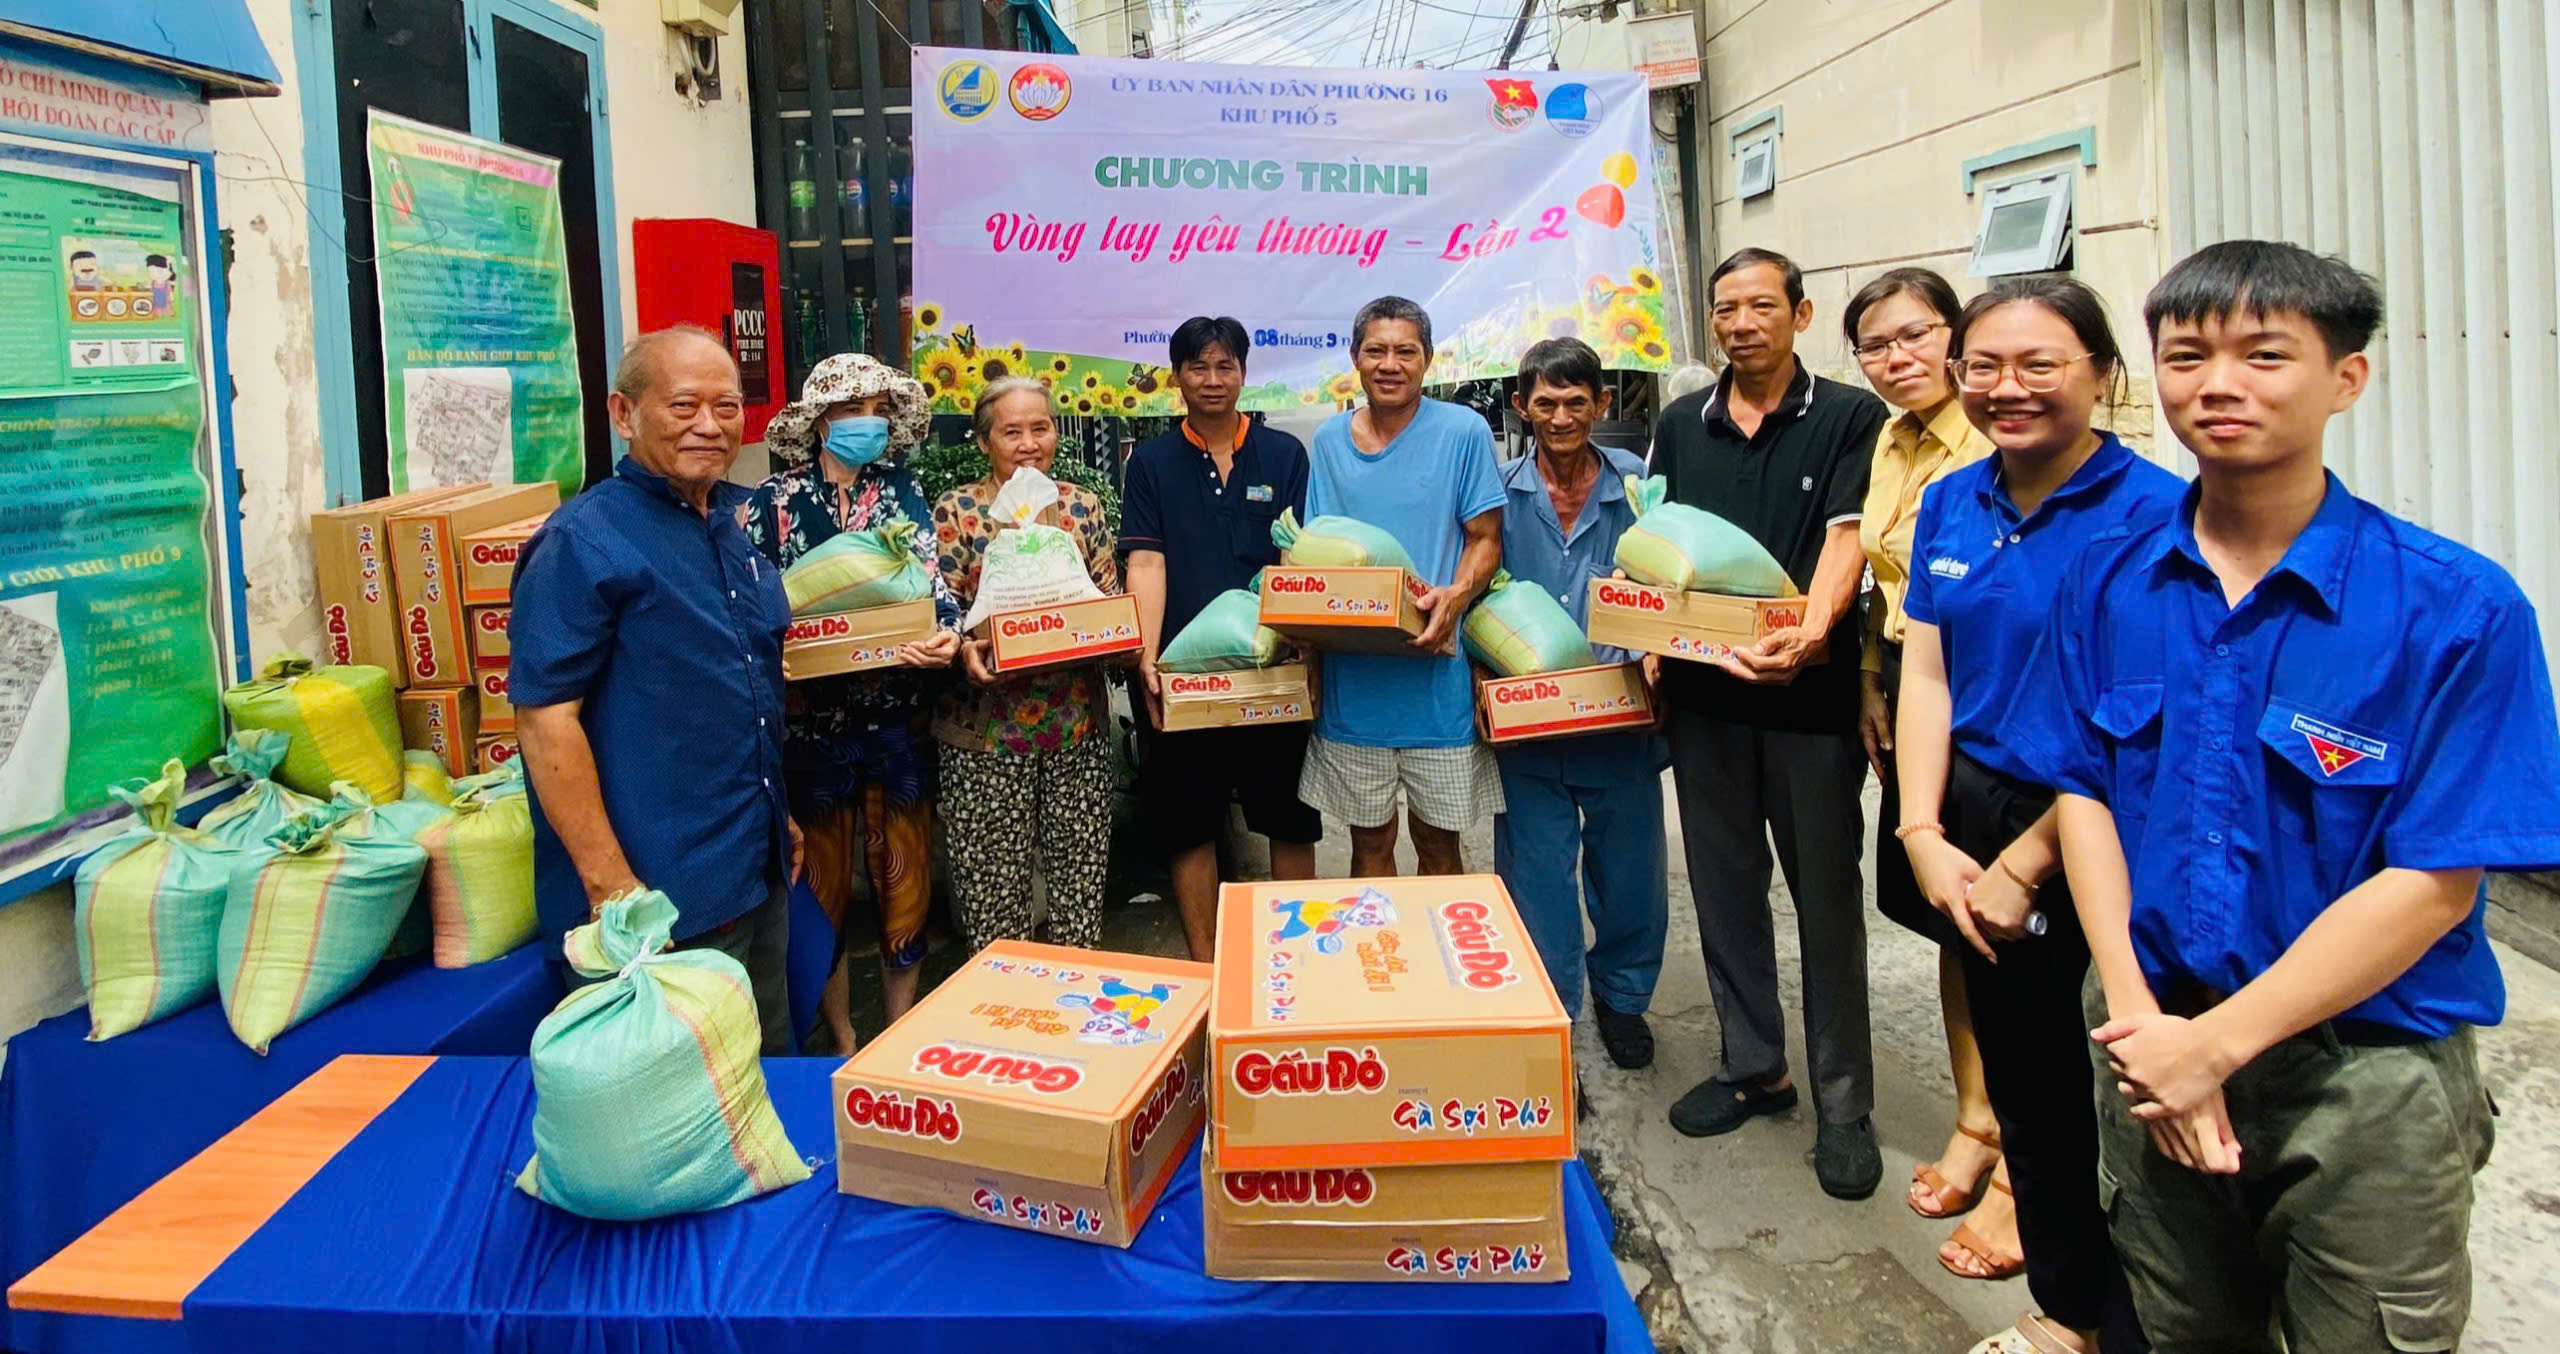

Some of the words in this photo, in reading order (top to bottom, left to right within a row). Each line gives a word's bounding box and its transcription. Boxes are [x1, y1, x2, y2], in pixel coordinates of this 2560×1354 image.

[19, 68, 55, 96] CHÍ
[60, 79, 110, 106] MINH
[165, 103, 174, 120] 4
[1112, 75, 1141, 92] ỦY
[1148, 79, 1194, 93] BAN
[1201, 77, 1264, 95] NHÂN
[1270, 79, 1318, 98] DÂN
[1323, 82, 1416, 102] PHƯỜNG
[1424, 88, 1448, 103] 16
[3, 96, 39, 124] HỘI
[1221, 107, 1266, 124] KHU
[1271, 104, 1319, 125] PHỐ
[1324, 112, 1338, 126] 5
[1095, 156, 1284, 191] CHƯƠNG
[1295, 156, 1428, 195] TRÌNH
[985, 212, 1087, 263] Vòng
[1100, 215, 1161, 263] tay
[1169, 215, 1242, 263] yêu
[1256, 216, 1388, 268] thương
[1439, 219, 1520, 262] Lần
[1529, 205, 1568, 242] 2
[734, 309, 765, 336] PCCC
[1124, 330, 1171, 344] Phườn
[1254, 328, 1279, 347] 08
[1280, 332, 1323, 349] tháng
[1326, 333, 1337, 347] 9
[64, 558, 115, 579] KHU
[119, 545, 165, 573] PHỐ
[331, 635, 351, 665] ấu
[1235, 1051, 1325, 1095] Gấu
[846, 1087, 913, 1133] Gấu
[1393, 1101, 1432, 1131] Gà
[1442, 1100, 1486, 1134] Sợi
[1495, 1097, 1551, 1127] Phở
[973, 1188, 1005, 1215] Gà
[1013, 1196, 1048, 1227] Sợi
[1053, 1202, 1102, 1233] Phở
[1386, 1248, 1425, 1272] Gà
[1435, 1246, 1479, 1277] Sợi
[1488, 1243, 1544, 1272] Phở
